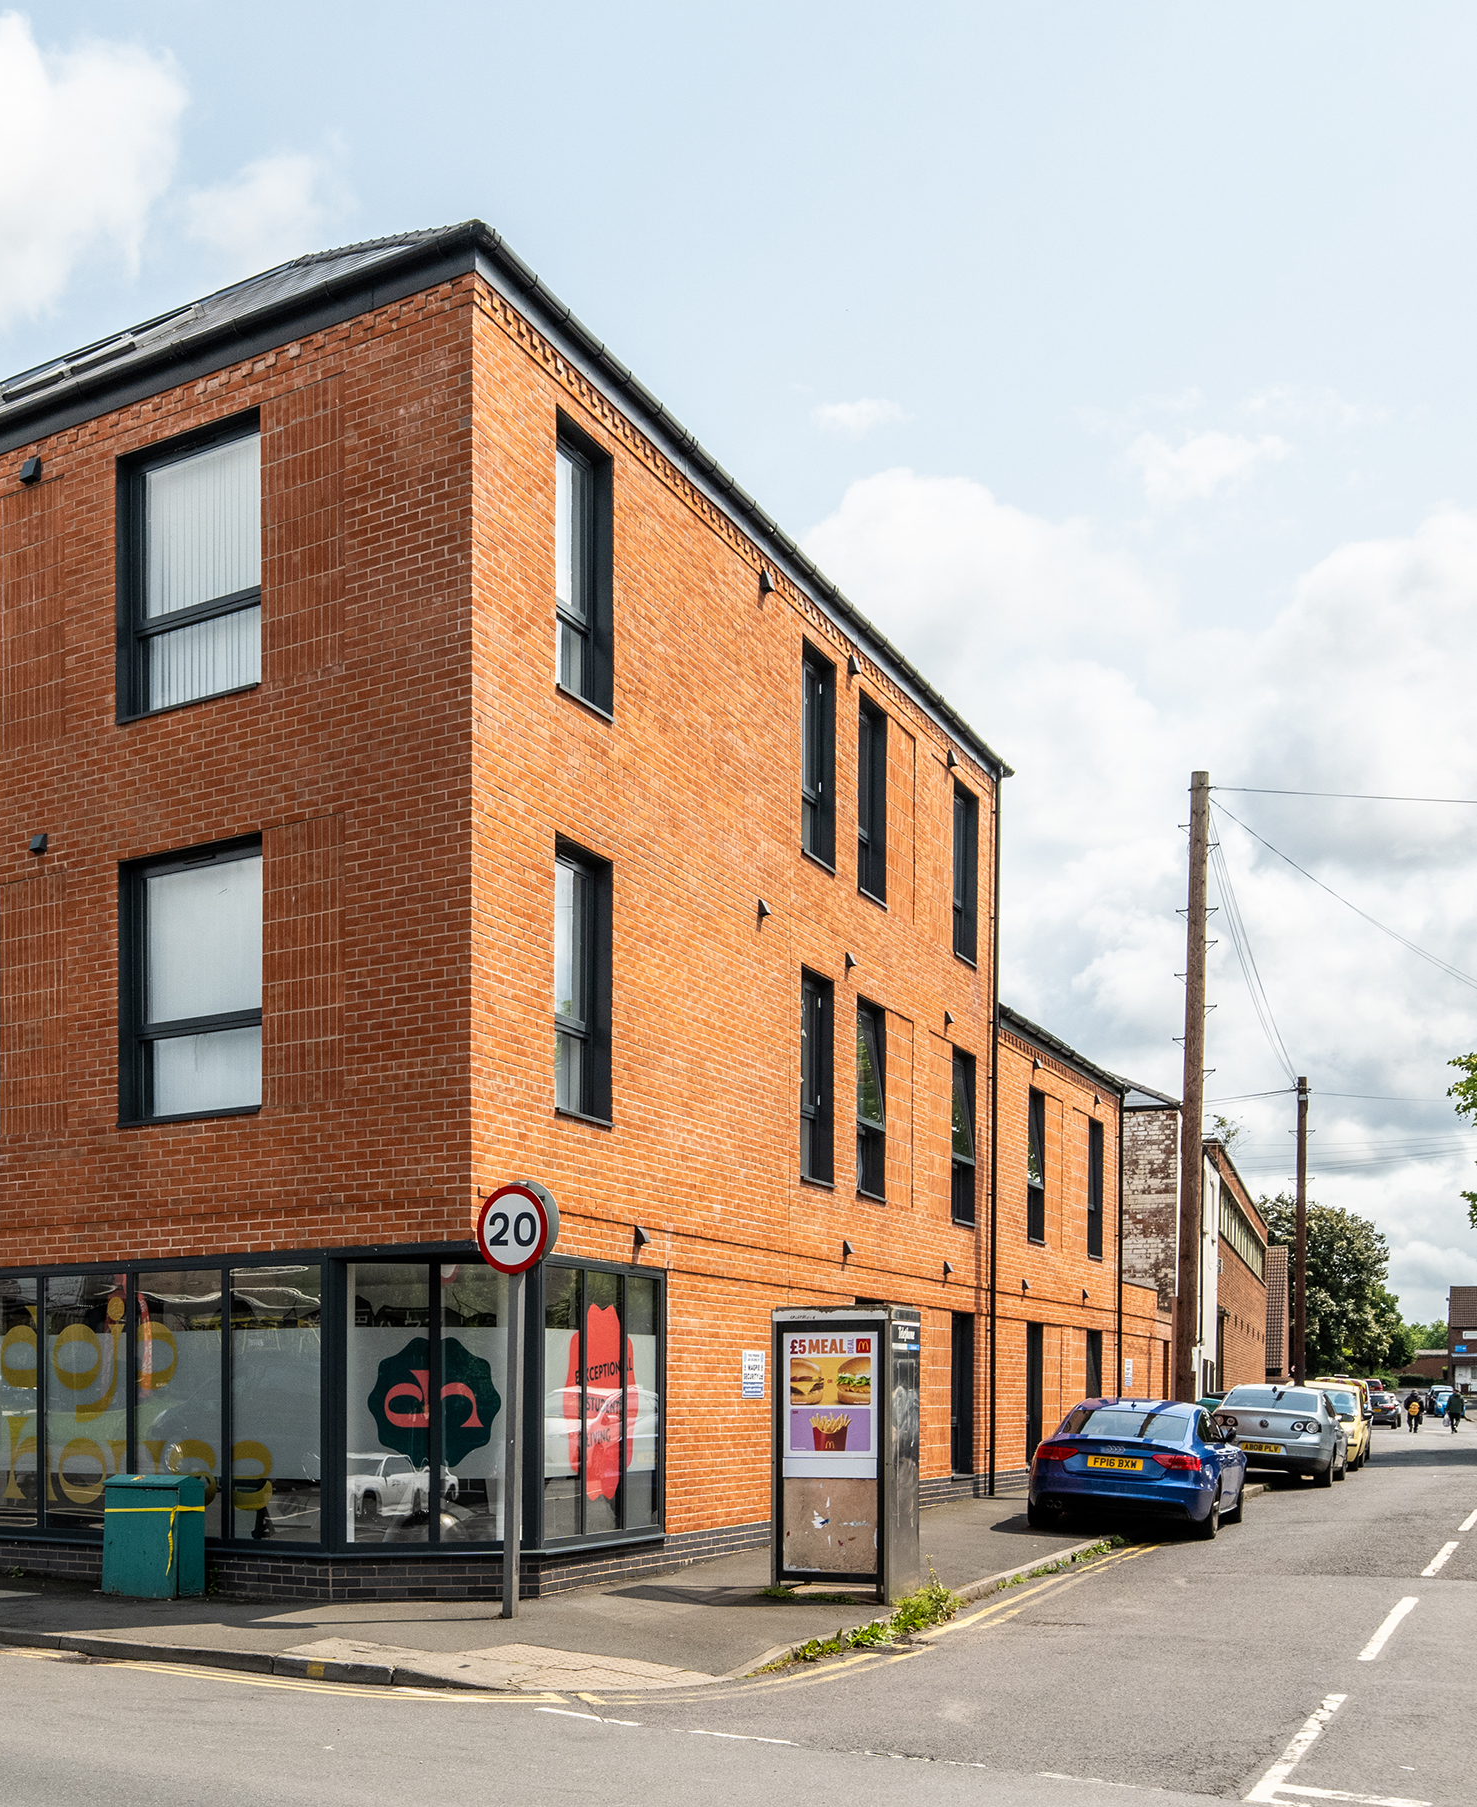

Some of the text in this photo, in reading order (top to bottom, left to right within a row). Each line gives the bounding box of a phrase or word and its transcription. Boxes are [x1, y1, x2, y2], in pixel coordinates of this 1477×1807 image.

[489, 1212, 537, 1247] 20
[790, 1339, 846, 1355] £5 MEAL
[575, 1357, 633, 1385] ECEPTIONL
[1093, 1457, 1137, 1469] FP16 BXW
